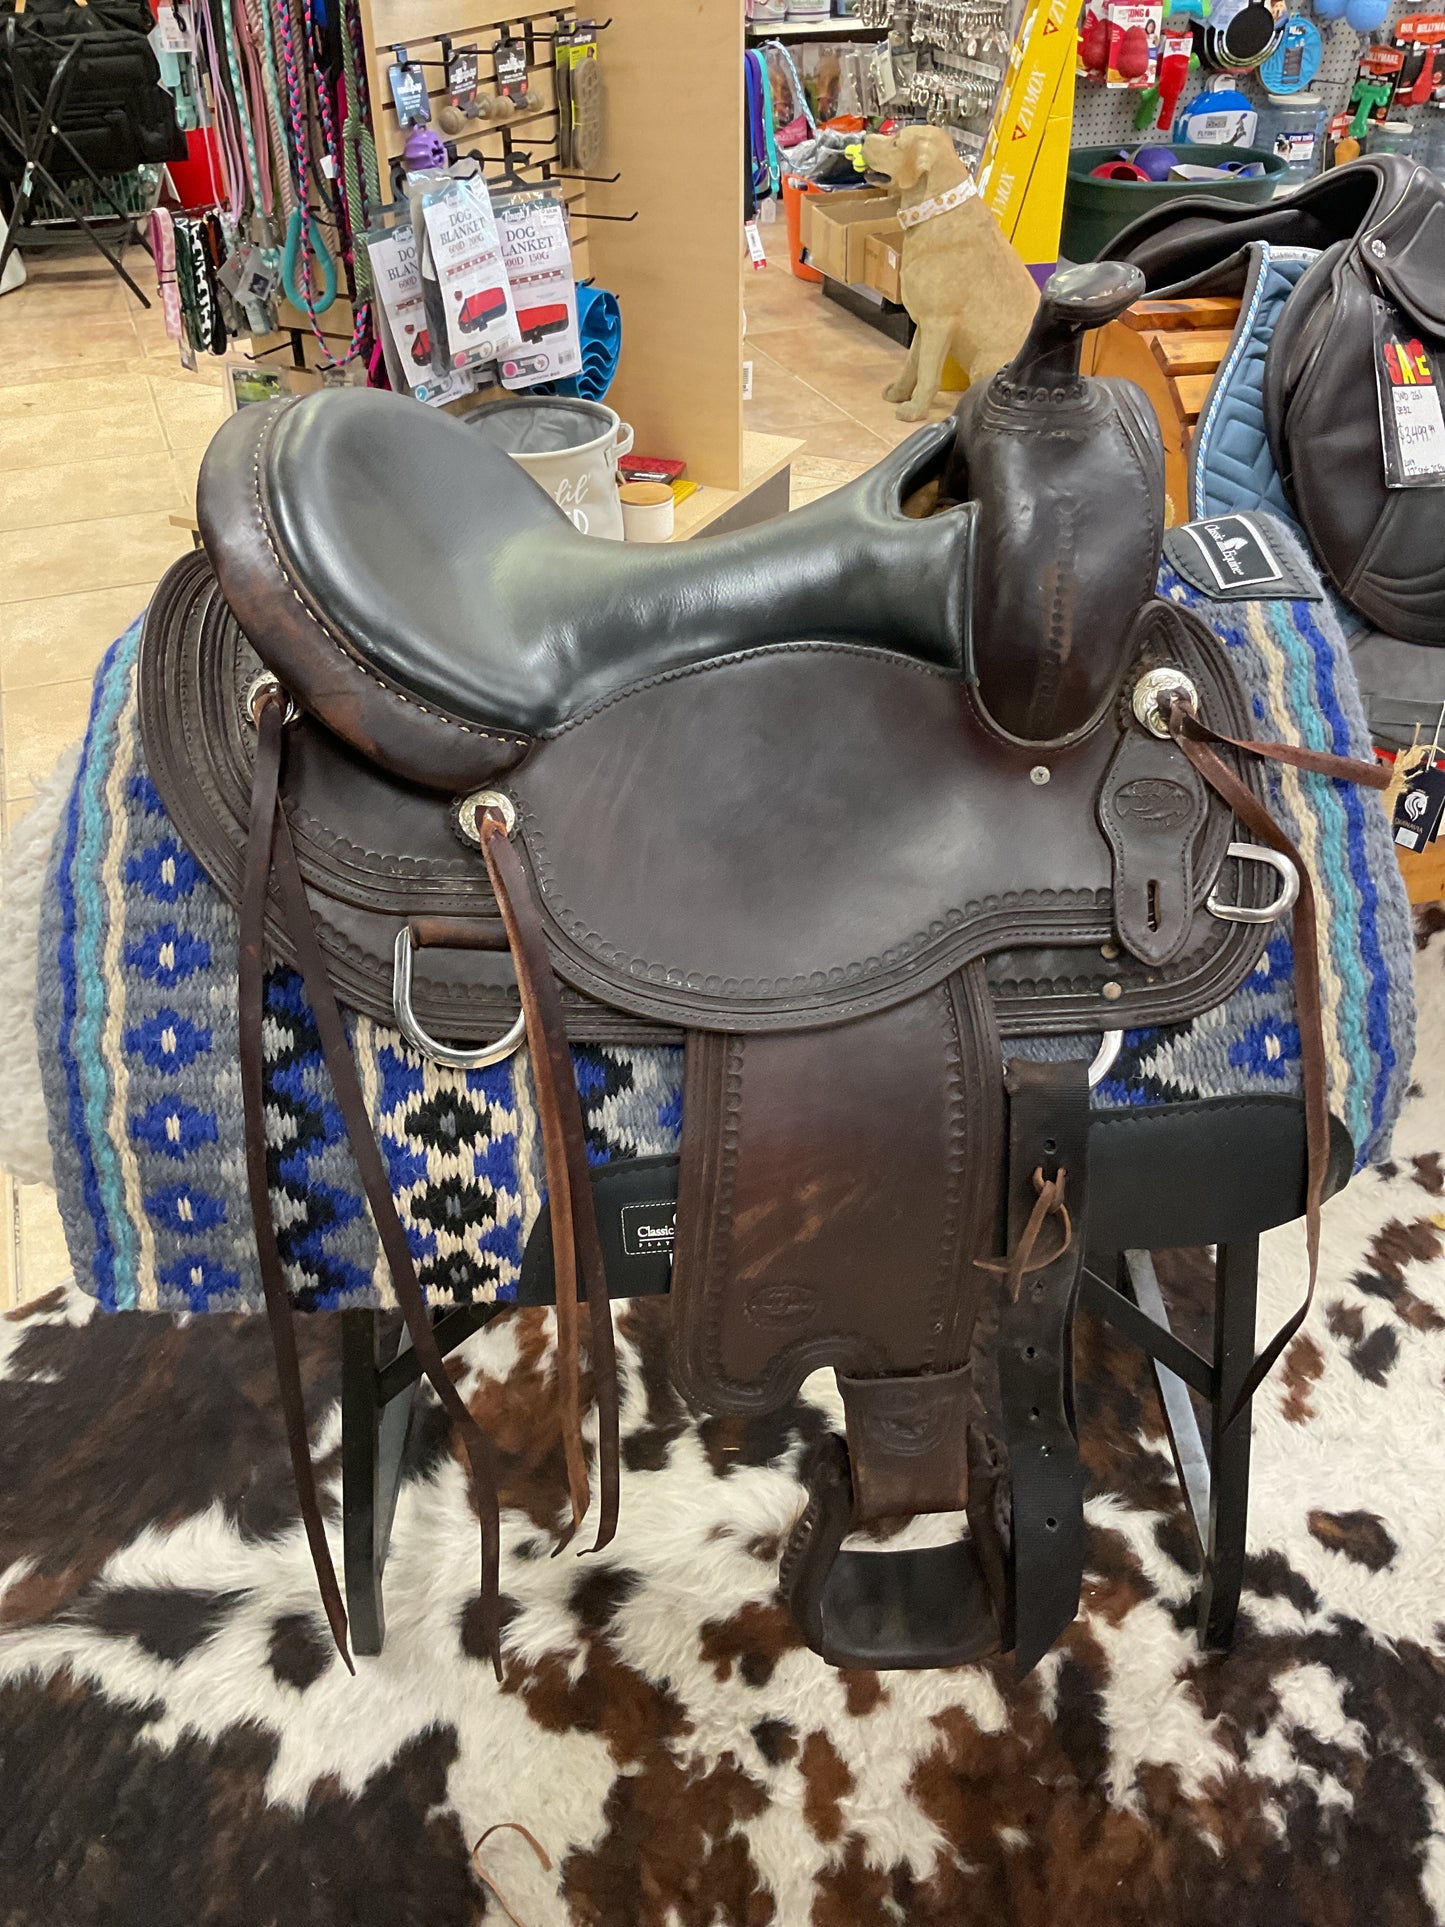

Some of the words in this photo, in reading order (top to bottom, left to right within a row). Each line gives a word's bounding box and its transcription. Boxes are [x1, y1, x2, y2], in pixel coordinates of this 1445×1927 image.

[1017, 70, 1047, 132] ZYMOX
[990, 173, 1016, 217] YMOX
[449, 209, 472, 227] DOG
[440, 217, 486, 246] BLANKET
[506, 226, 536, 242] DOG
[397, 246, 416, 262] DO
[501, 236, 554, 257] LANKET
[529, 251, 550, 263] 150G
[387, 261, 418, 281] BLAN
[399, 276, 417, 289] 600D
[1384, 338, 1433, 385] SALE
[1204, 524, 1226, 544] Classic
[1222, 549, 1243, 576] Equine
[637, 1225, 675, 1238] Classic
